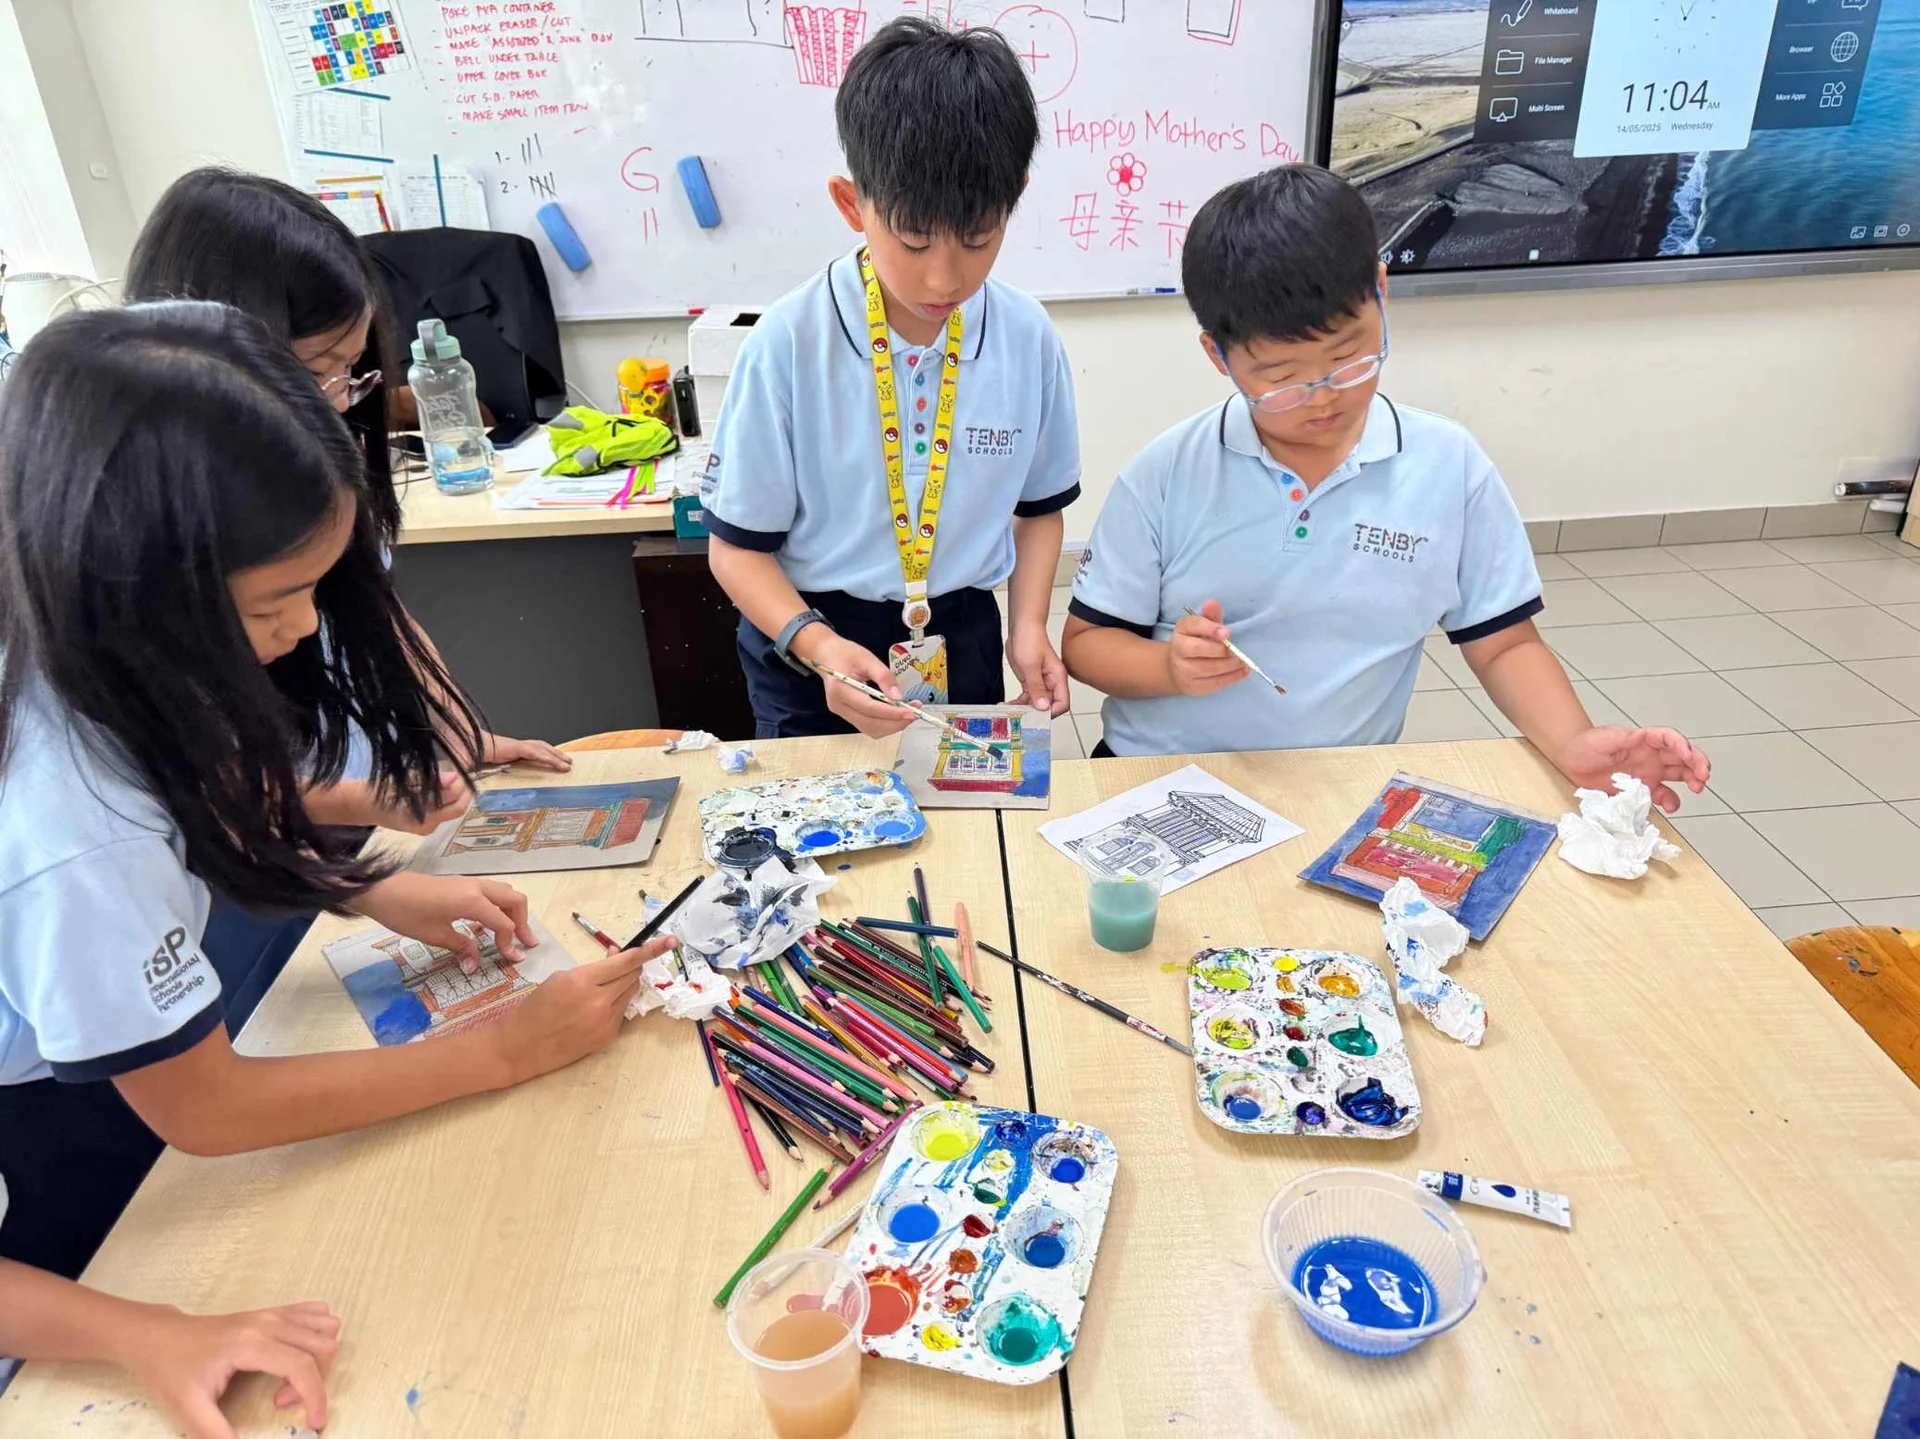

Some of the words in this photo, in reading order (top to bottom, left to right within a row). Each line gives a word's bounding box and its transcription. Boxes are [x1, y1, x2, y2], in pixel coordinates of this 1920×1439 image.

[1544, 7, 1579, 15] Whiteboard
[1534, 57, 1545, 65] File
[1547, 56, 1573, 65] Manager
[1623, 80, 1708, 113] 11:04
[1706, 101, 1720, 110] AM
[1545, 104, 1565, 112] Screen
[1671, 121, 1714, 131] Wednesday
[1054, 109, 1136, 153] Happy
[1145, 110, 1246, 152] Mother's
[967, 447, 1013, 455] SCHOOLS
[1353, 543, 1414, 563] SCHOOLS
